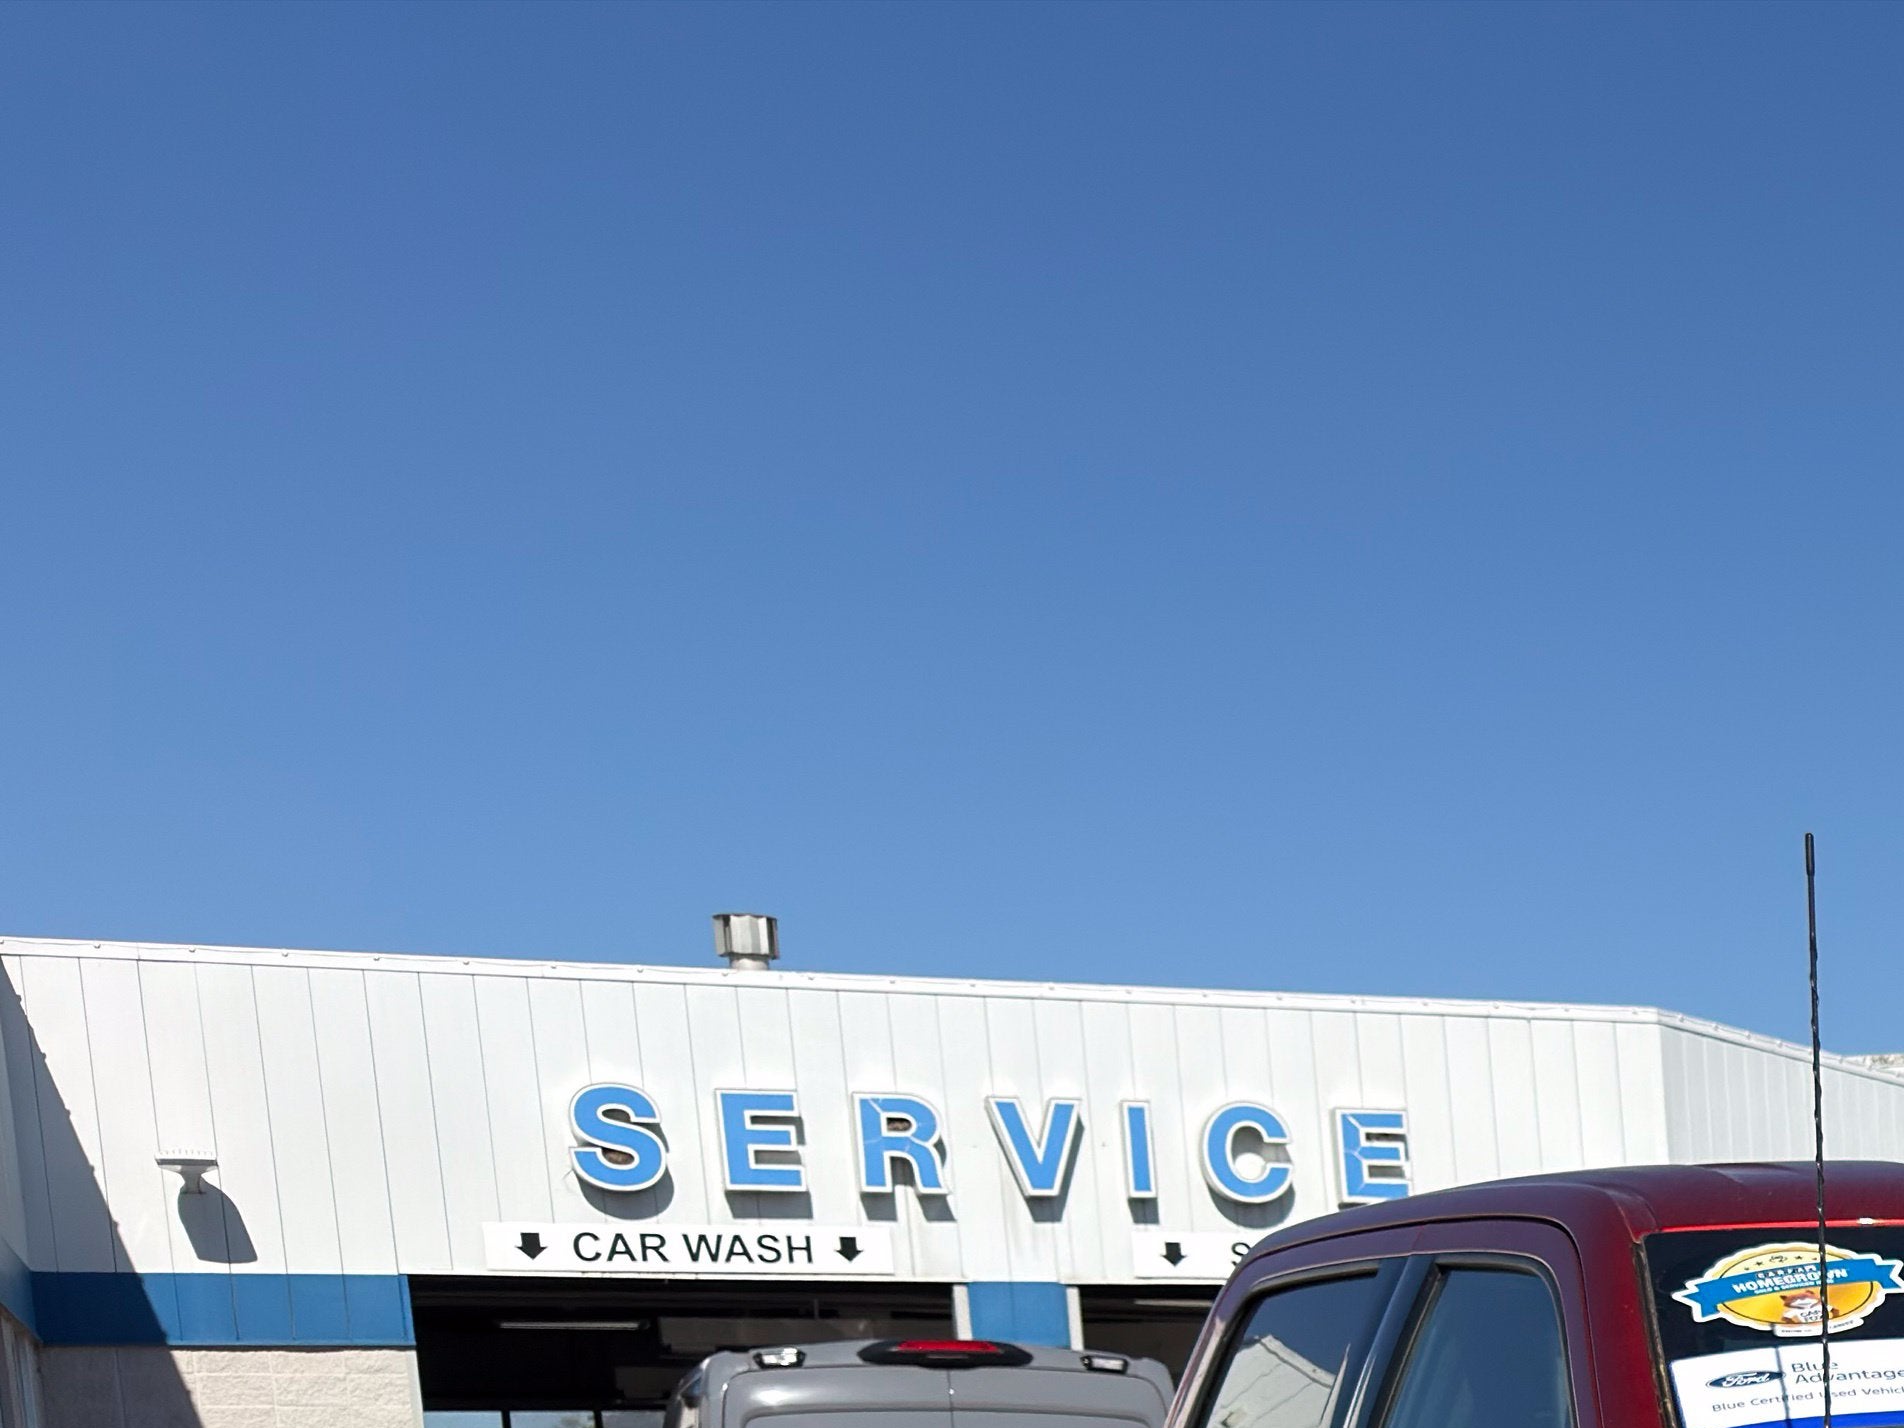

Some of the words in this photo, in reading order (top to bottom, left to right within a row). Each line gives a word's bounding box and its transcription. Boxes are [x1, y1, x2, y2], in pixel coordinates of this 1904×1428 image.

[567, 1082, 1410, 1205] SERVICE
[572, 1231, 671, 1263] CAR
[681, 1233, 814, 1264] WASH
[1722, 1372, 1771, 1389] Ford
[1791, 1361, 1838, 1373] Blue
[1712, 1399, 1746, 1412] Blue
